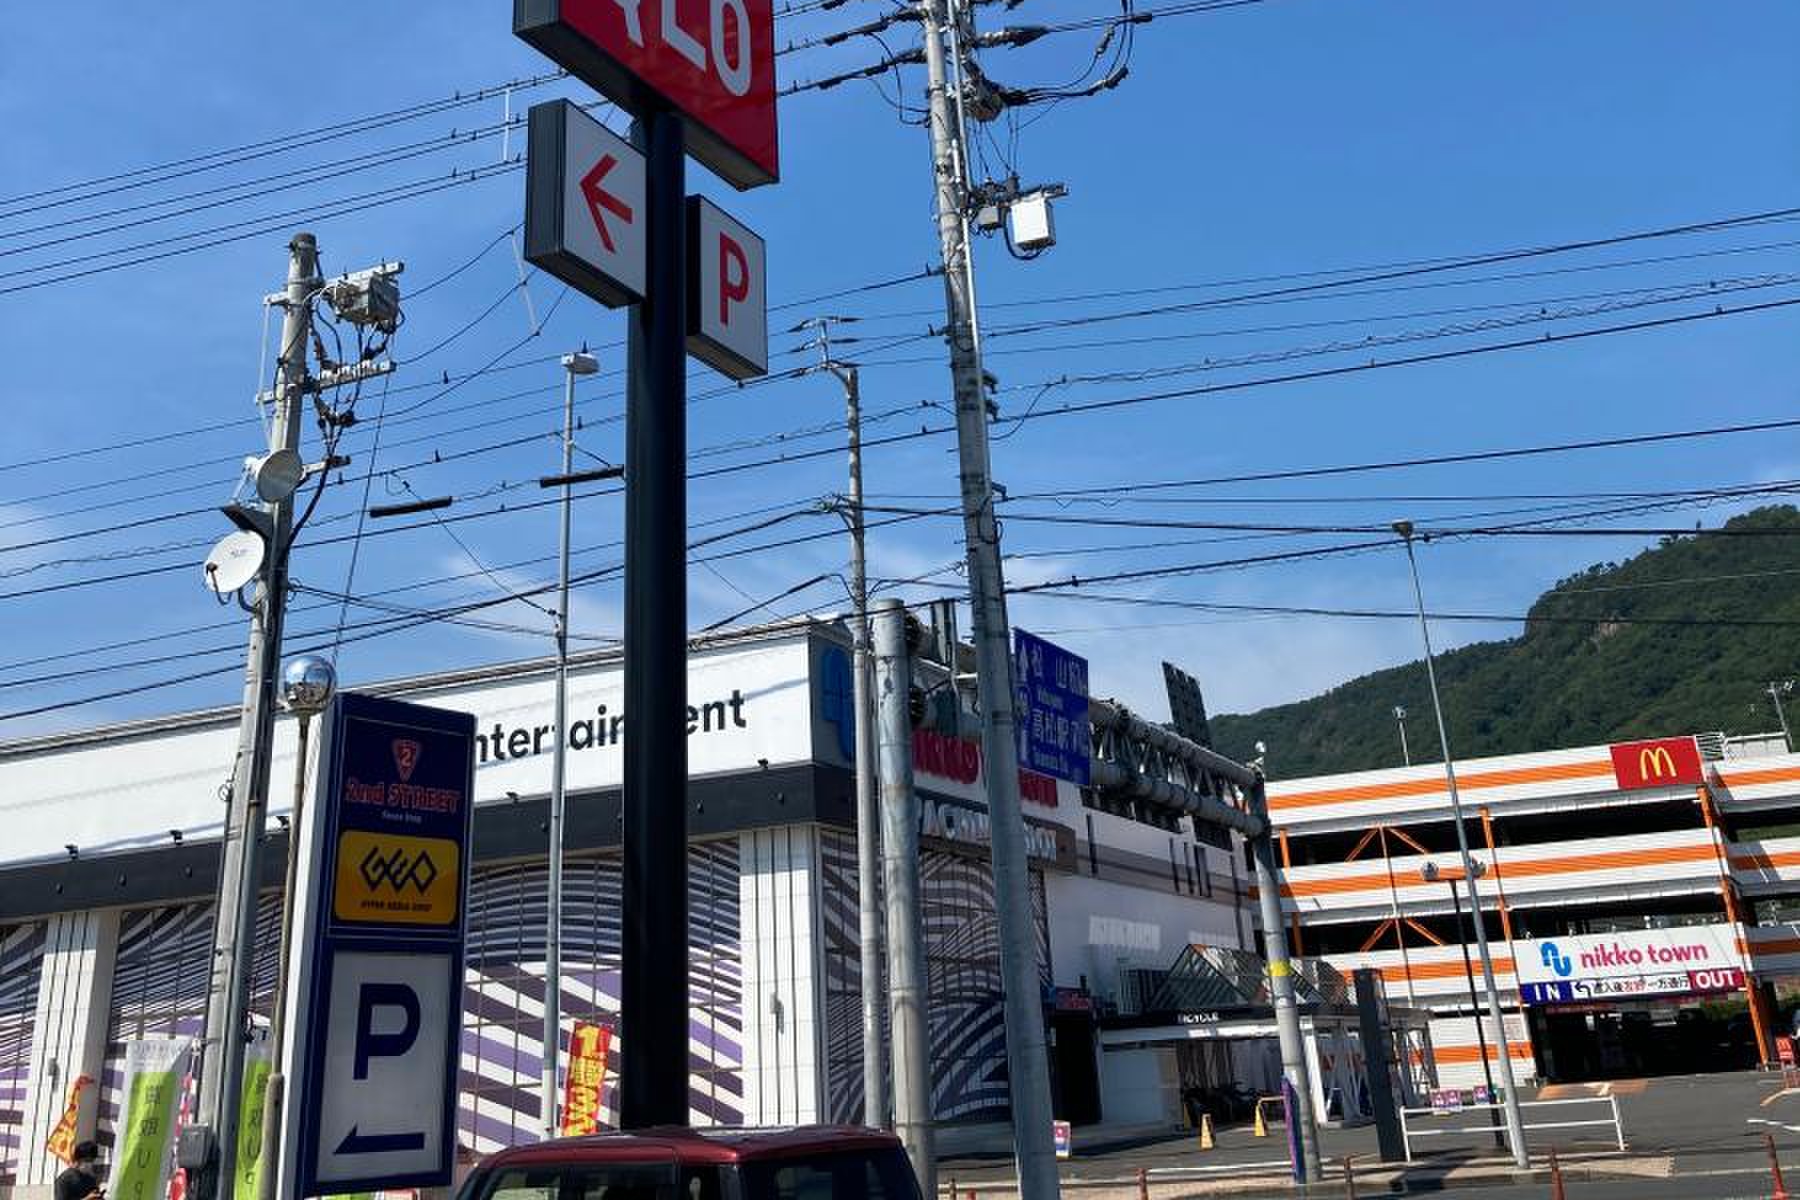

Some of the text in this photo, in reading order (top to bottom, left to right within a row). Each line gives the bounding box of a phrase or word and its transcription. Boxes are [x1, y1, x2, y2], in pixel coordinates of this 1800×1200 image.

[718, 230, 750, 327] P
[387, 782, 462, 814] STREET
[359, 846, 438, 895] GEO
[1580, 942, 1709, 969] nikko town
[1533, 985, 1561, 1002] IN
[1694, 969, 1736, 990] OUT
[353, 981, 422, 1081] P
